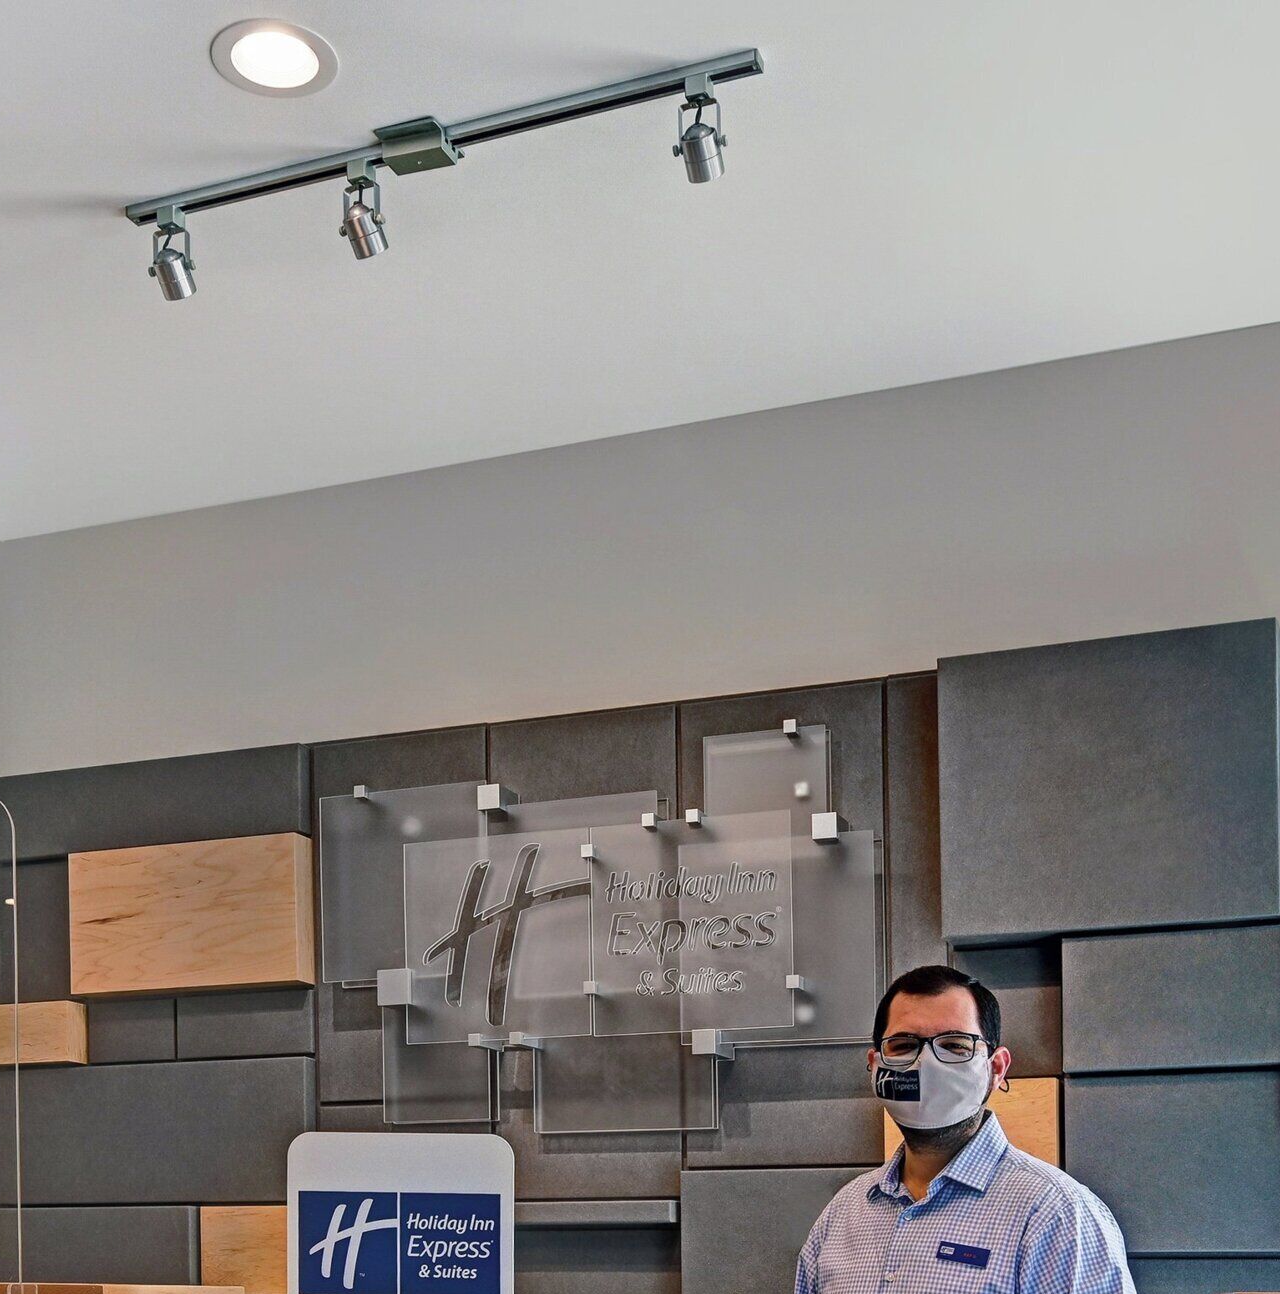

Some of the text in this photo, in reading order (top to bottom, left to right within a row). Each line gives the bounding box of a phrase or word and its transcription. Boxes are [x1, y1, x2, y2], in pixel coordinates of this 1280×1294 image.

[605, 862, 776, 903] Holiday Inn
[607, 912, 777, 965] Express
[636, 967, 743, 996] & Suites
[406, 1213, 495, 1234] Holiday Inn
[408, 1235, 491, 1263] Express
[419, 1265, 477, 1279] & Suites
